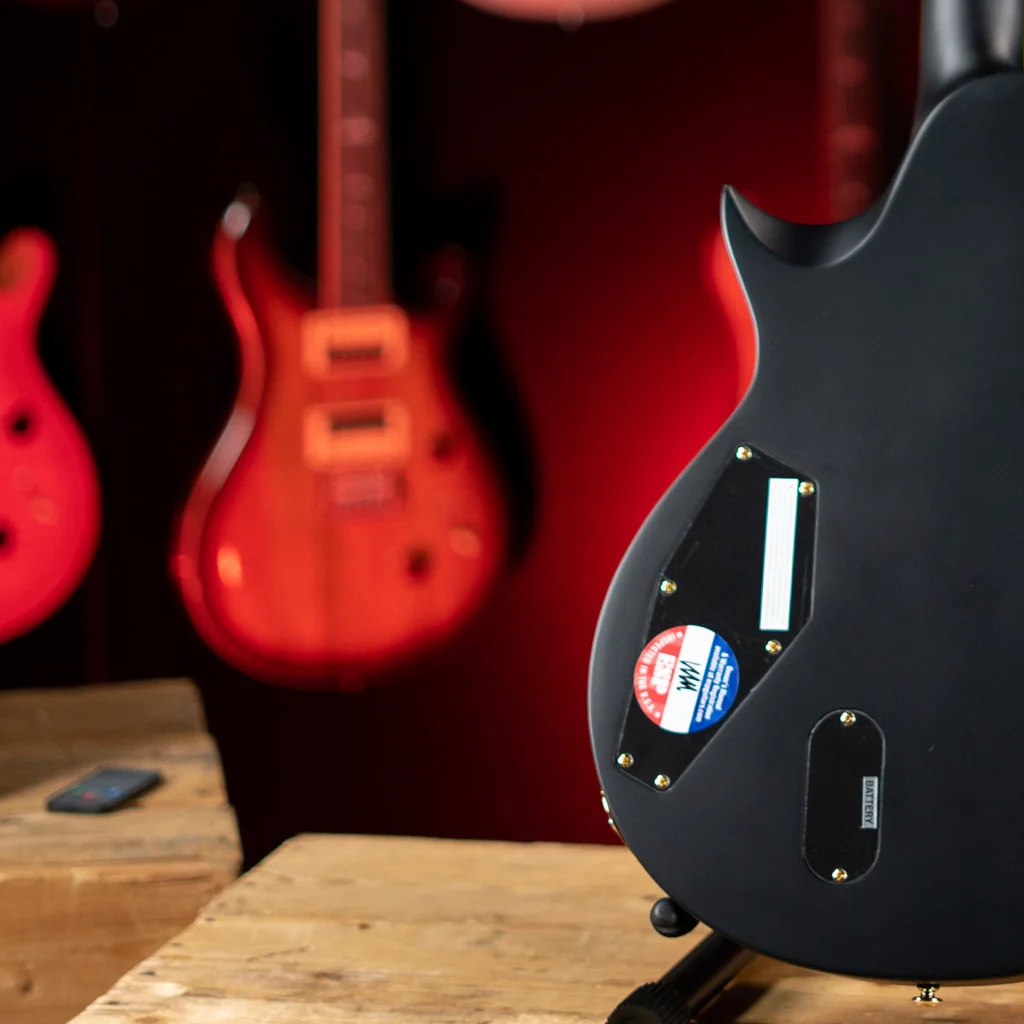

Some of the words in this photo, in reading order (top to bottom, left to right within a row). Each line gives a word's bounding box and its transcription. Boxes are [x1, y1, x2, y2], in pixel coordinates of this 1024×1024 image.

[642, 632, 675, 664] INSPECTED
[639, 665, 647, 674] IN
[713, 658, 727, 684] Warranty
[704, 684, 719, 720] Registration
[865, 780, 874, 824] BATTERY
